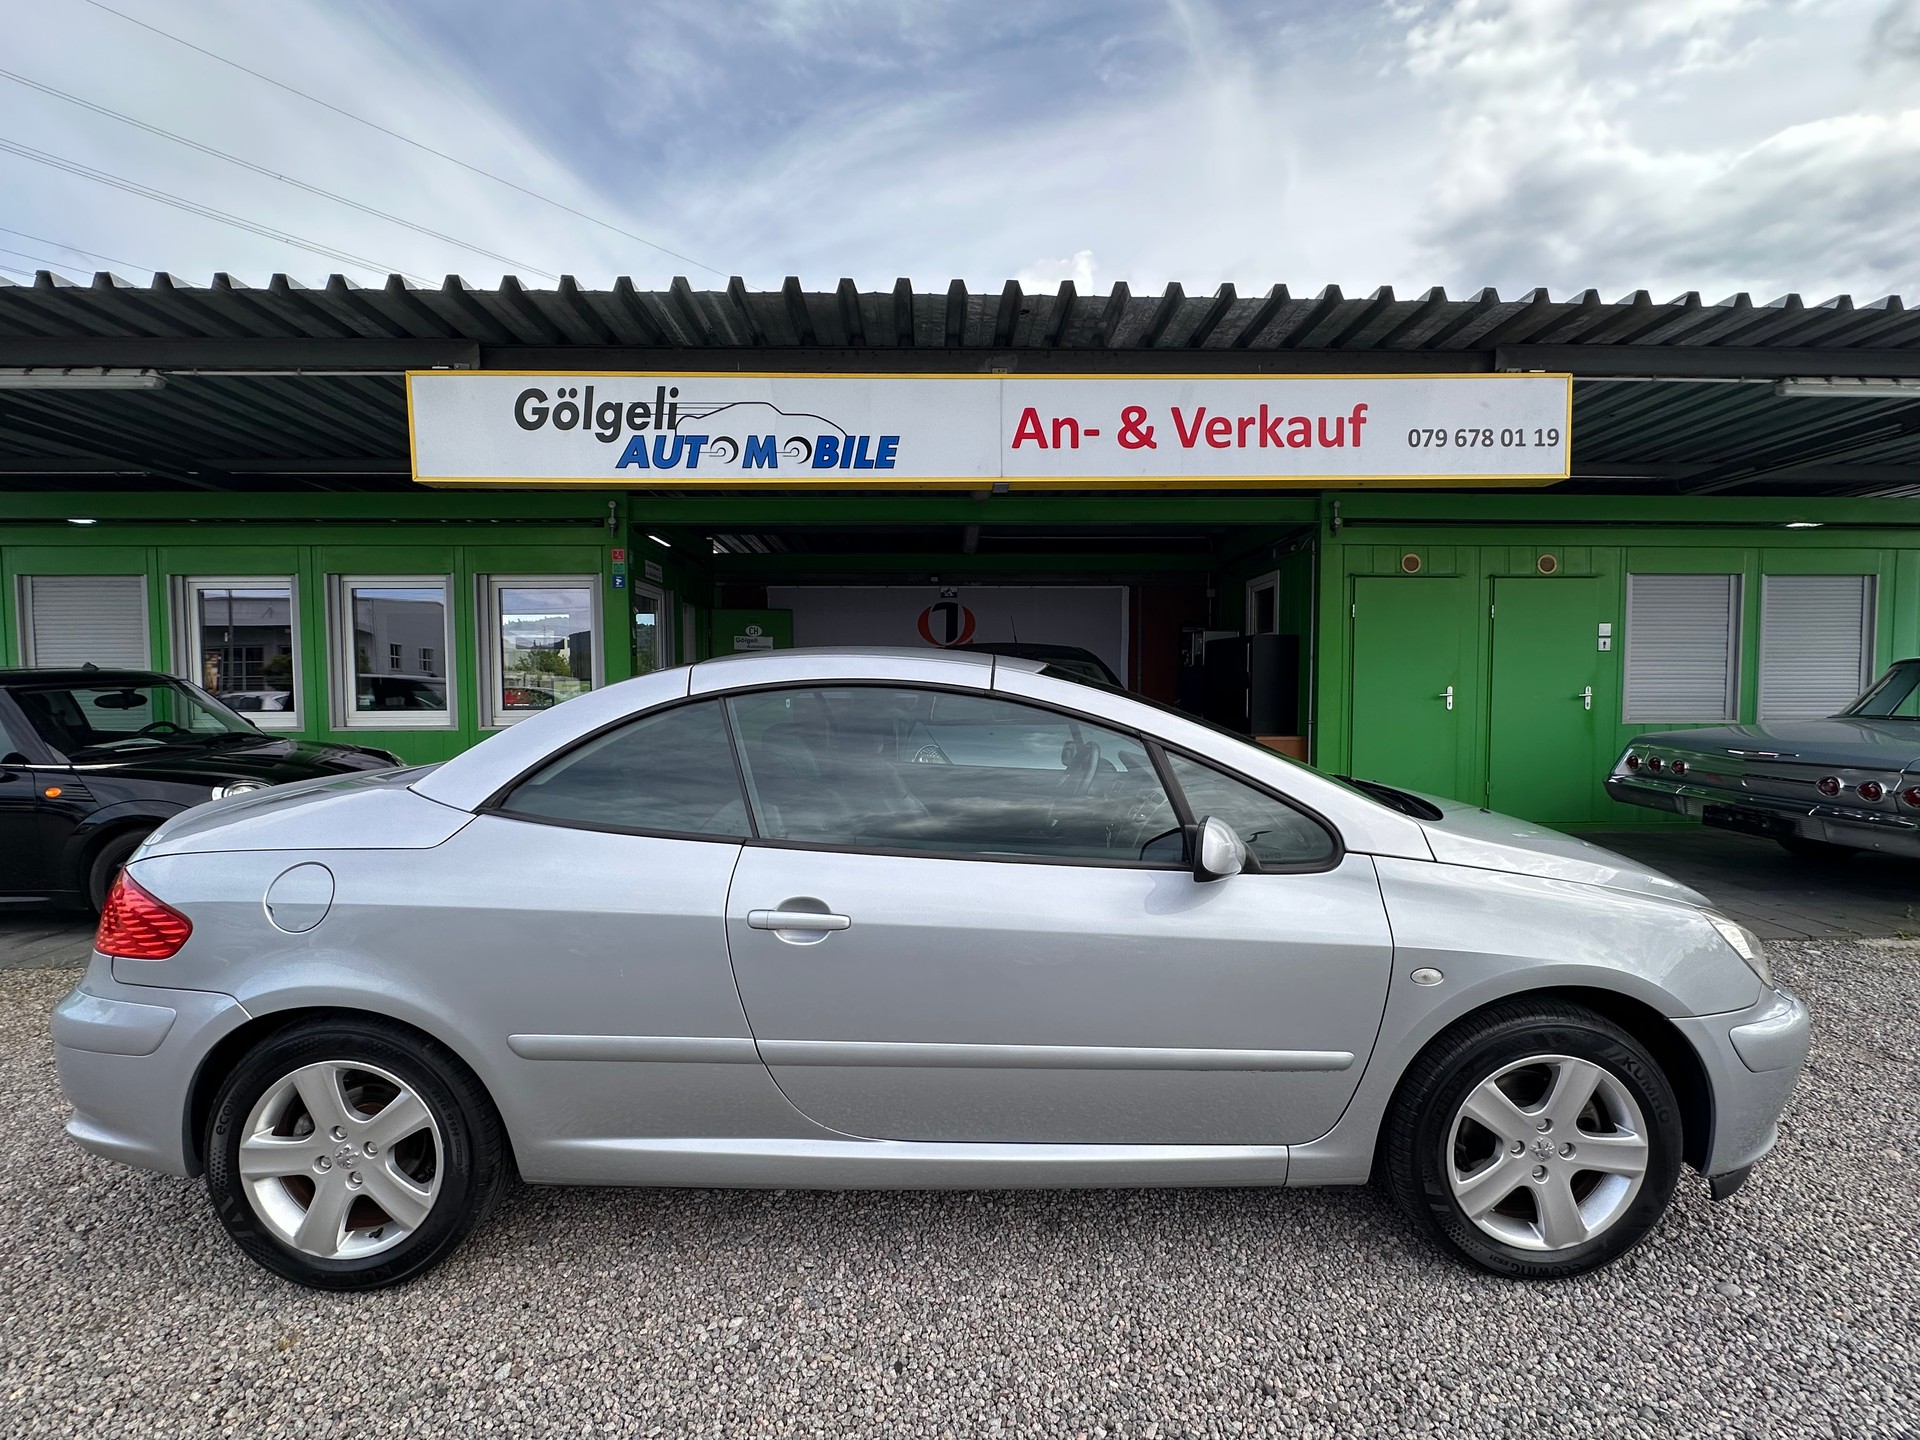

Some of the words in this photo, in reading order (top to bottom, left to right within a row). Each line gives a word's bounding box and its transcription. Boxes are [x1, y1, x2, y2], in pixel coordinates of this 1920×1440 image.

[513, 385, 680, 443] Gölgeli
[1011, 406, 1100, 450] An-
[1117, 404, 1158, 450] &
[1169, 402, 1369, 450] Verkauf
[1407, 427, 1449, 449] 079
[1454, 427, 1494, 449] 678
[1500, 427, 1527, 449] 01
[1533, 427, 1560, 449] 19
[748, 626, 759, 635] CH
